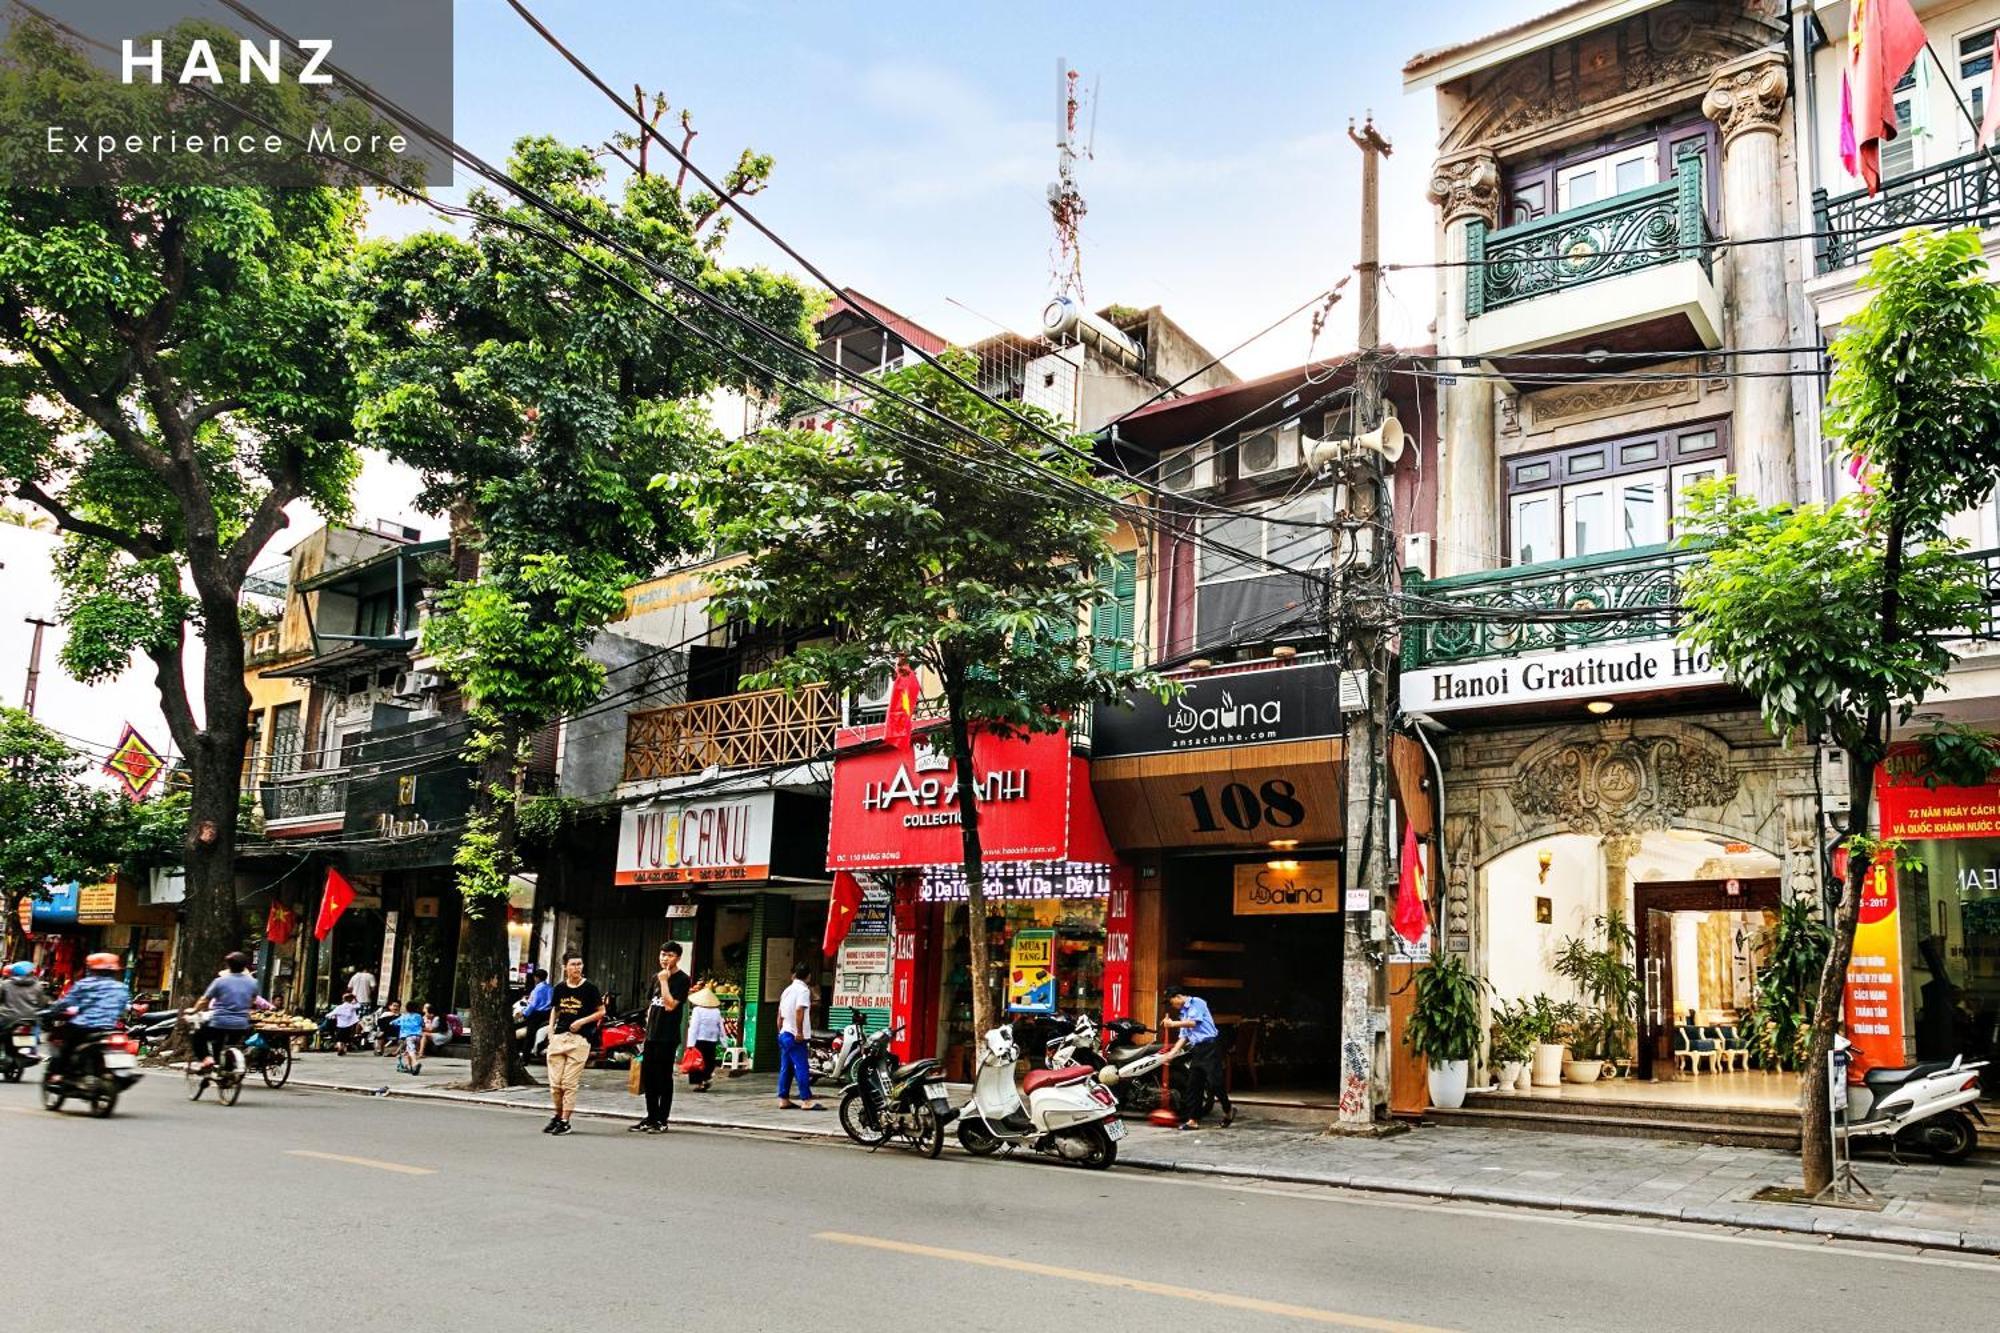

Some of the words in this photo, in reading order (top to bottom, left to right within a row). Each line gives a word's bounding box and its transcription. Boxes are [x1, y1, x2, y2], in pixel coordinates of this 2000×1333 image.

[1432, 668, 1510, 702] Hanoi
[1521, 652, 1658, 691] Gratitude
[1672, 647, 1725, 677] Ho
[1175, 684, 1281, 734] Sauna
[1171, 730, 1277, 748] ansachnhe.com
[862, 763, 939, 810] HAO
[903, 810, 963, 828] COLLECTI
[1180, 779, 1306, 833] 108
[982, 878, 1003, 896] ách
[1033, 877, 1051, 894] Da
[1065, 876, 1093, 897] Dây
[1256, 871, 1323, 905] Sauna
[1869, 897, 1888, 908] 2017
